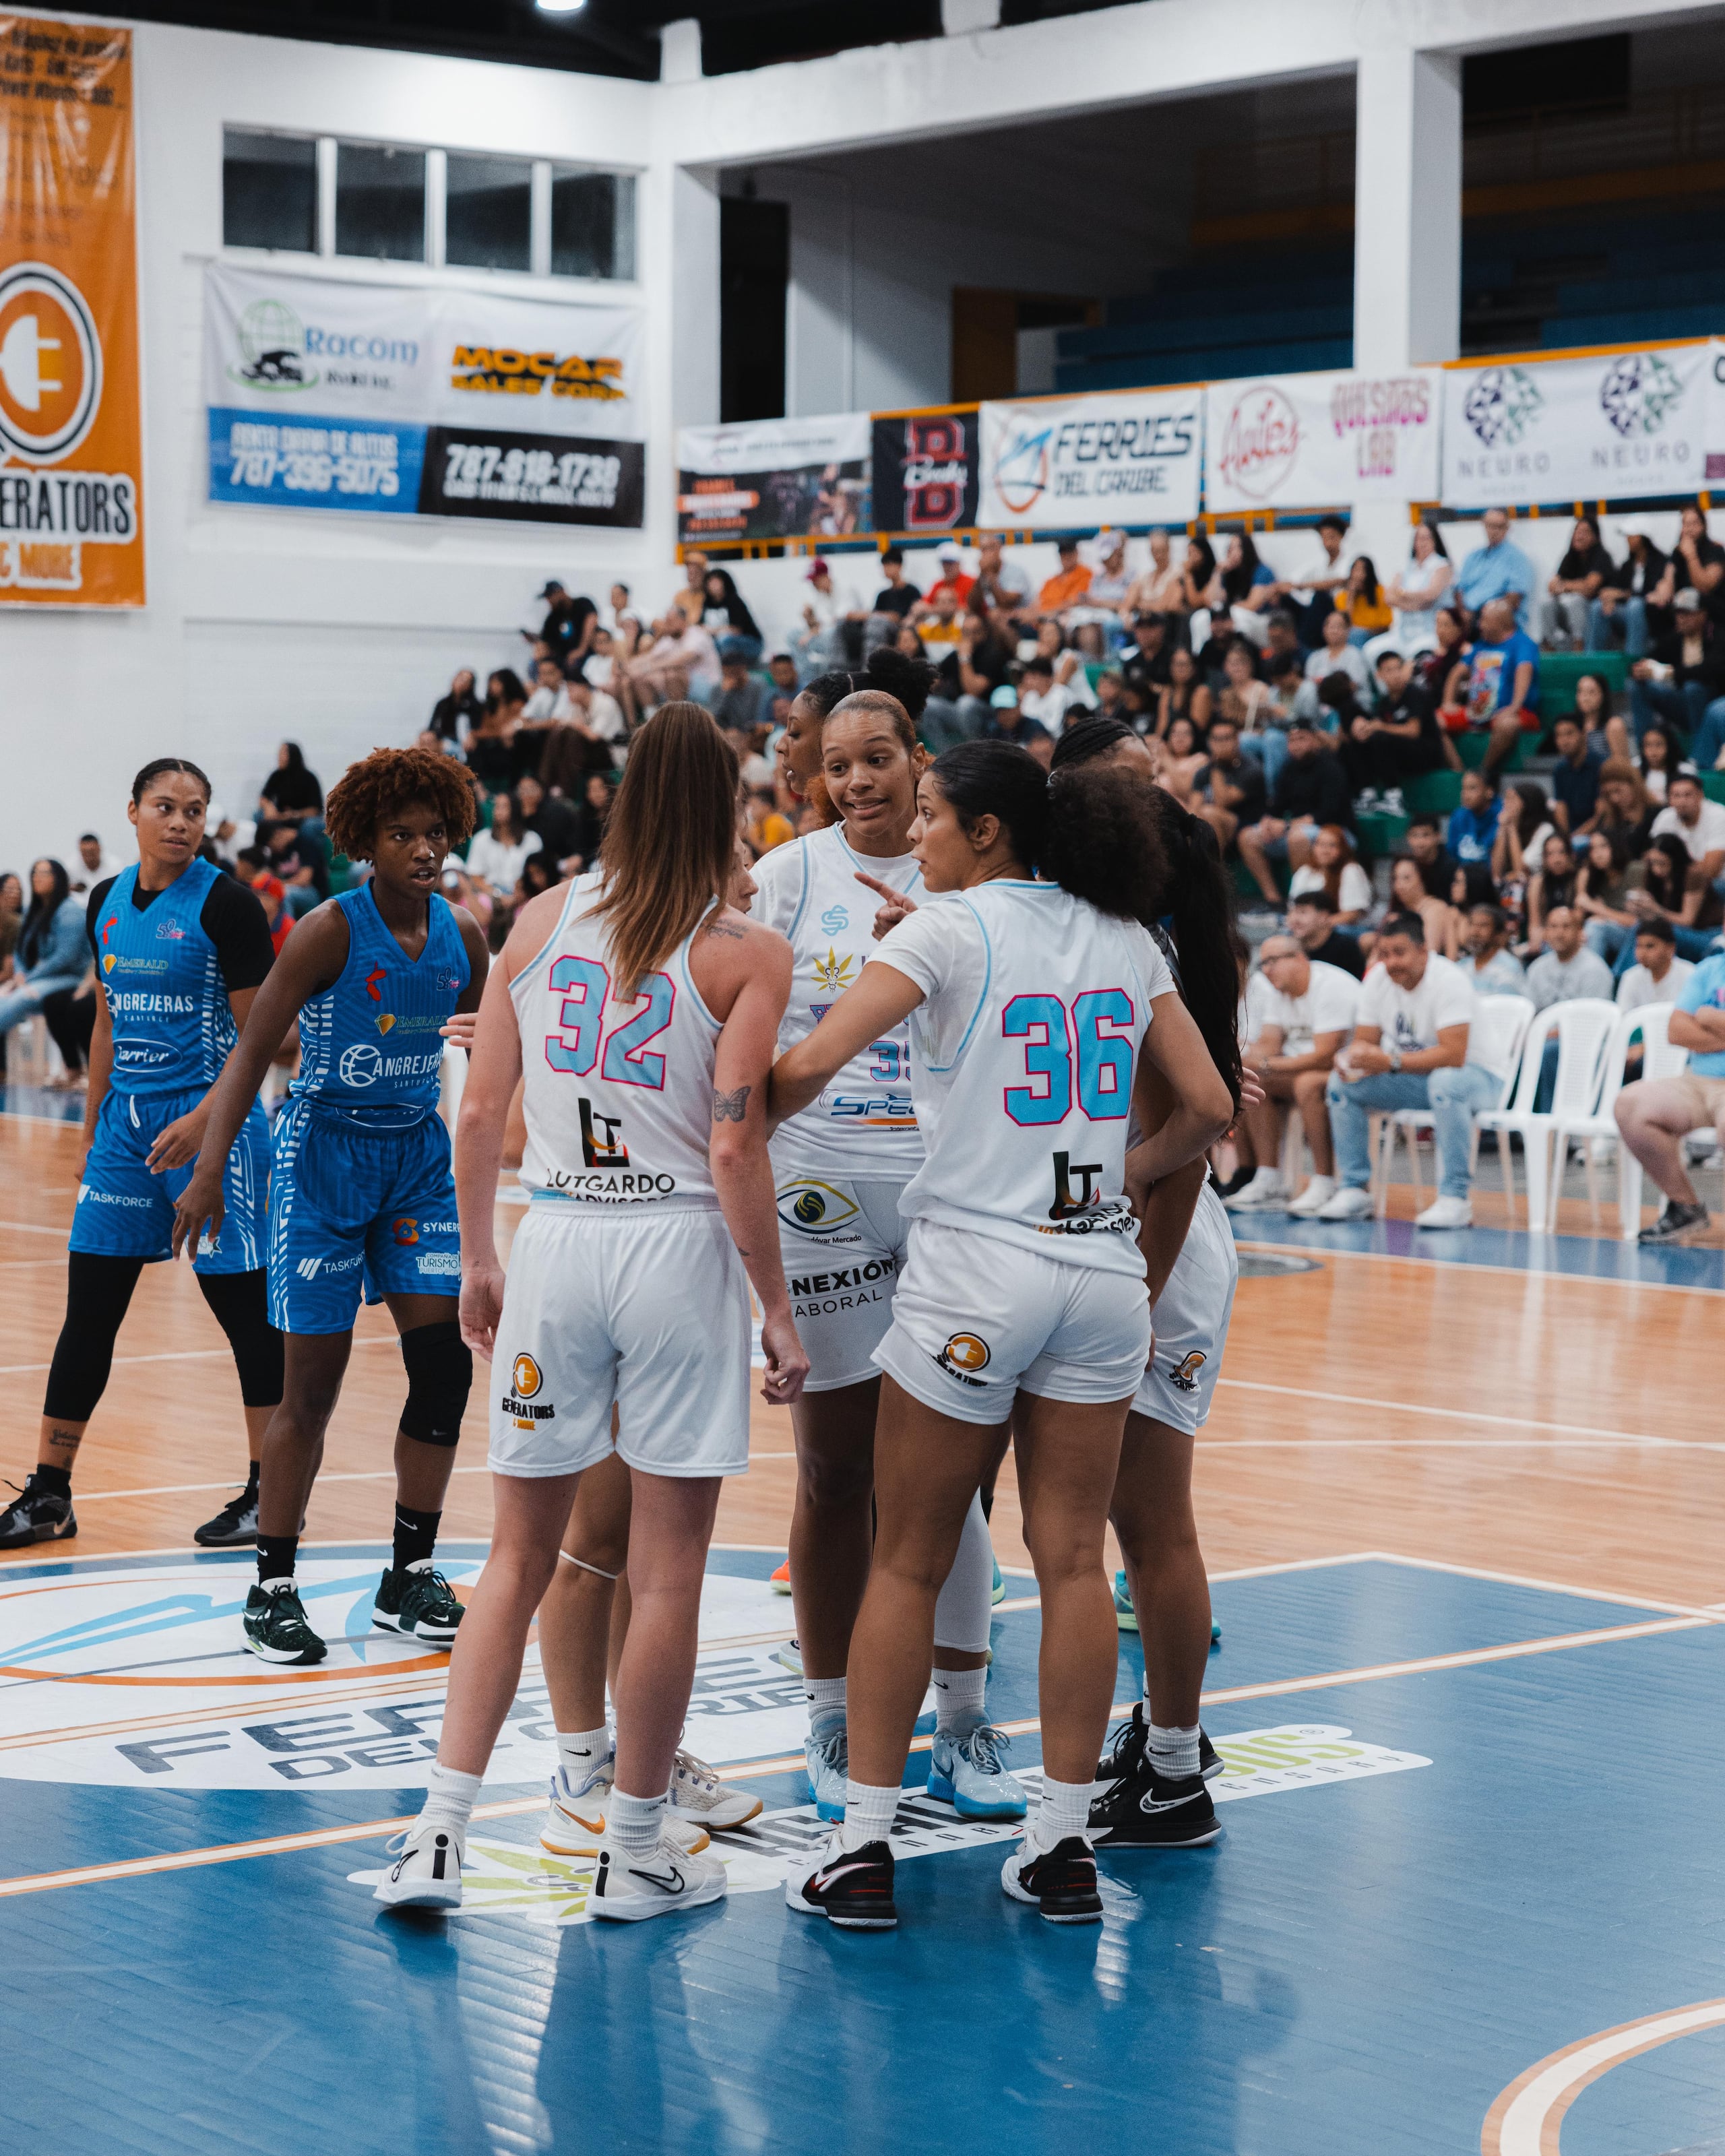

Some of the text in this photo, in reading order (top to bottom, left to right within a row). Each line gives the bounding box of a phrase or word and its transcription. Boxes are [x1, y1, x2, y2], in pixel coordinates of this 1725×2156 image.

[452, 345, 623, 381] MOCAR
[1053, 415, 1194, 463] FERRIES
[1457, 451, 1549, 478] NEURO
[1592, 441, 1690, 469] NEURO
[0, 477, 130, 534] ERATORS
[545, 954, 677, 1091] 32
[117, 1046, 170, 1063] arrier
[869, 1040, 912, 1082] 3
[1001, 987, 1134, 1127] 36
[546, 1168, 675, 1194] LUTGARDO
[89, 1191, 154, 1208] TASKFORCE
[422, 1222, 461, 1233] SYNER
[832, 1234, 862, 1244] Mercado
[417, 1257, 458, 1268] TURISMO
[791, 1259, 894, 1296] NEXIÓN
[795, 1290, 883, 1318] ABORAL
